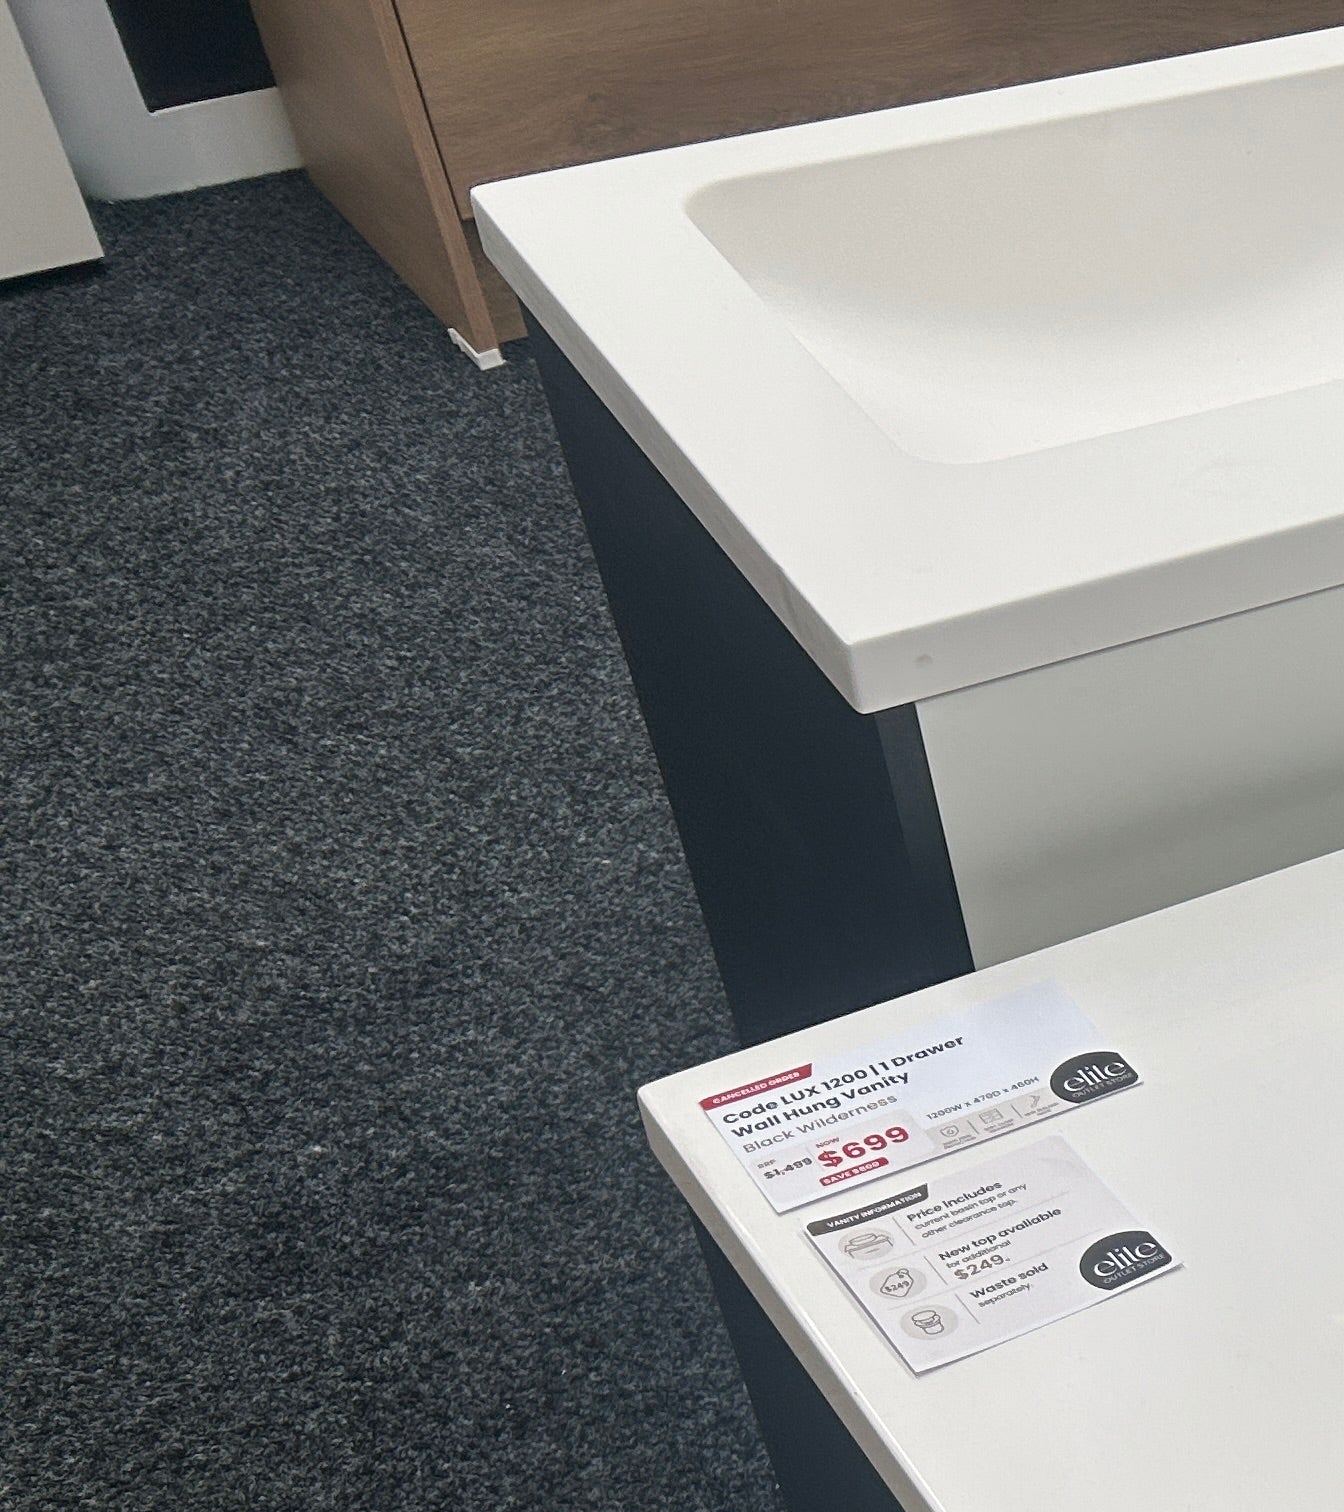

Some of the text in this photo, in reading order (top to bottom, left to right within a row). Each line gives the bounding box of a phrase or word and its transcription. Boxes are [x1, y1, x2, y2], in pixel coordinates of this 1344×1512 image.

[711, 1071, 800, 1104] CANCELLED ORDER
[721, 1099, 779, 1125] Code
[779, 1084, 821, 1105] LUX
[820, 1068, 869, 1091] 1200
[889, 1035, 965, 1067] Drawer
[1059, 1059, 1128, 1093] elite
[1071, 1071, 1133, 1098] OUTLET STORE
[730, 1070, 910, 1138] Wall Hung Vanity
[925, 1102, 963, 1120] 1200W
[741, 1093, 898, 1153] Black Wilderness
[814, 1135, 840, 1149] NOW
[816, 1124, 910, 1168] $699
[762, 1156, 813, 1180] $1,499
[822, 1170, 852, 1185] SAVE
[825, 1190, 922, 1229] VANITY INFORMATION
[905, 1181, 1003, 1222] Price includes
[913, 1182, 1028, 1230] current basin top or any
[920, 1224, 948, 1239] other
[947, 1205, 998, 1228] clearance
[937, 1207, 1062, 1261] New top available
[944, 1238, 1012, 1269] for additional
[952, 1252, 1011, 1280] $249.
[1089, 1239, 1160, 1277] elite
[1101, 1252, 1166, 1284] OUTLET STORE
[968, 1261, 1049, 1299] Waste sold
